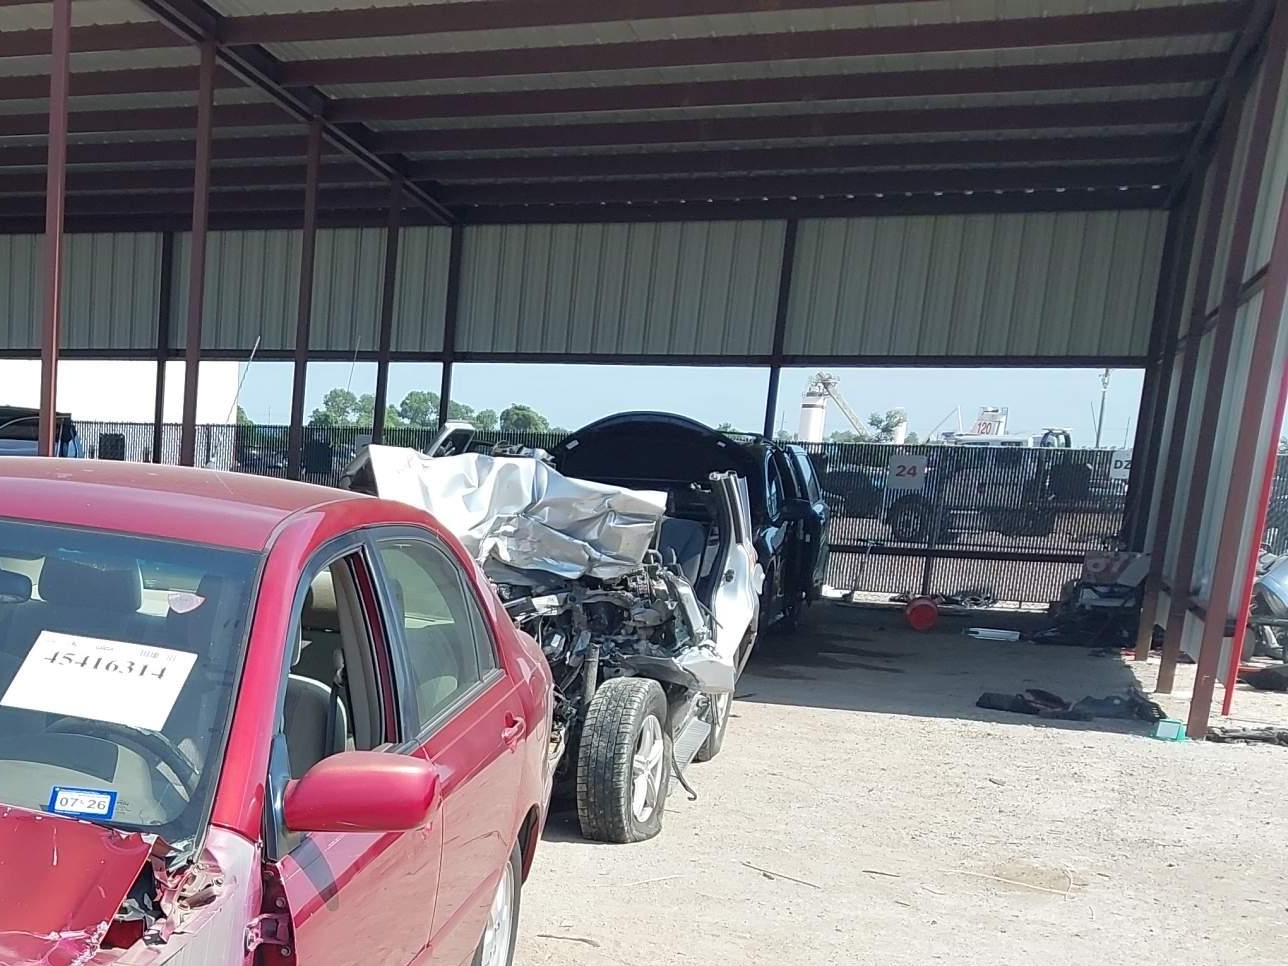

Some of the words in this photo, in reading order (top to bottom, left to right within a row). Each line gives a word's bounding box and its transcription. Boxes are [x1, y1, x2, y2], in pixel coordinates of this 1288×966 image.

[977, 422, 992, 435] 120
[895, 464, 918, 478] 24
[42, 650, 167, 680] 45416314
[59, 797, 78, 808] 07
[86, 799, 107, 810] 26
